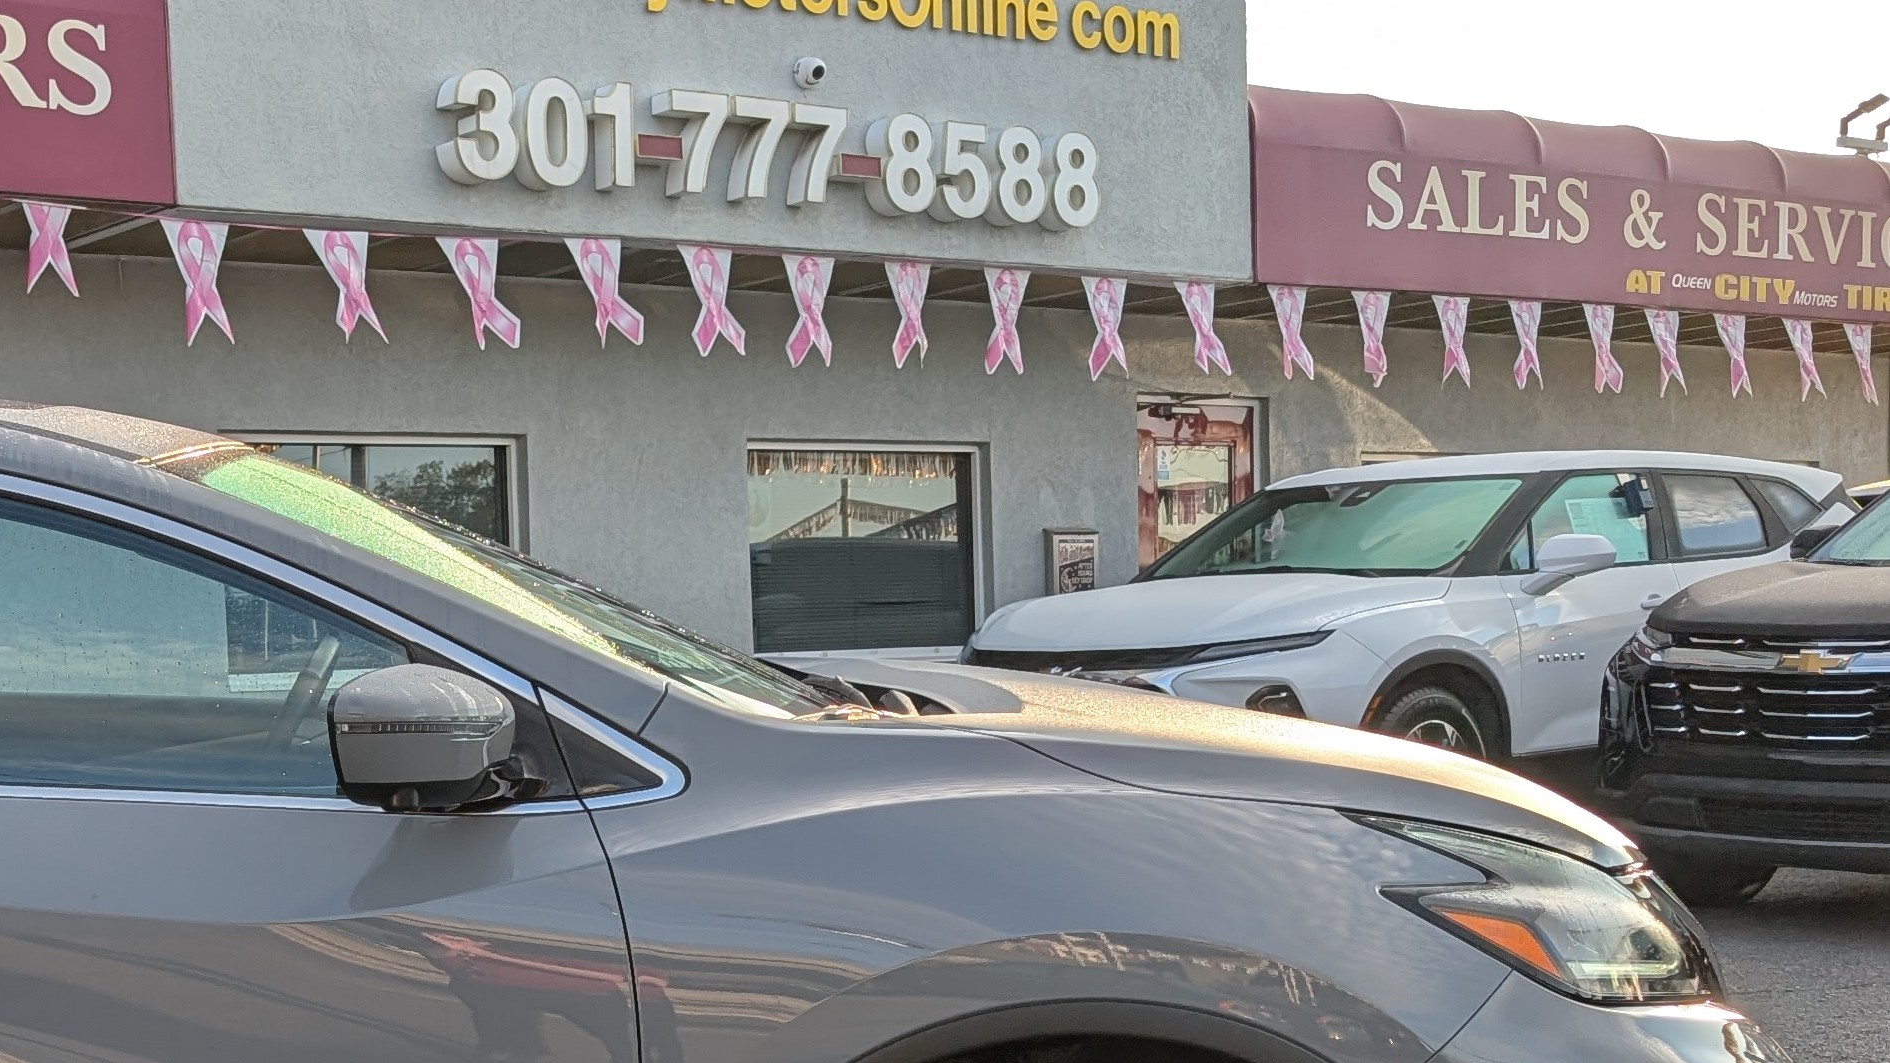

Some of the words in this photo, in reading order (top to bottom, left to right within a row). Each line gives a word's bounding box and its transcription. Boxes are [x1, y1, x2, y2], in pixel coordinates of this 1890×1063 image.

[436, 68, 1102, 231] 301-777-8588
[1366, 160, 1590, 244] SALES
[1623, 189, 1667, 250] &
[1696, 192, 1890, 269] SERVI
[1625, 269, 1666, 295] AT
[1671, 273, 1712, 290] QUEEN
[1714, 273, 1796, 305] CITY
[1793, 290, 1839, 308] MOTORS
[1842, 284, 1890, 312] TIR
